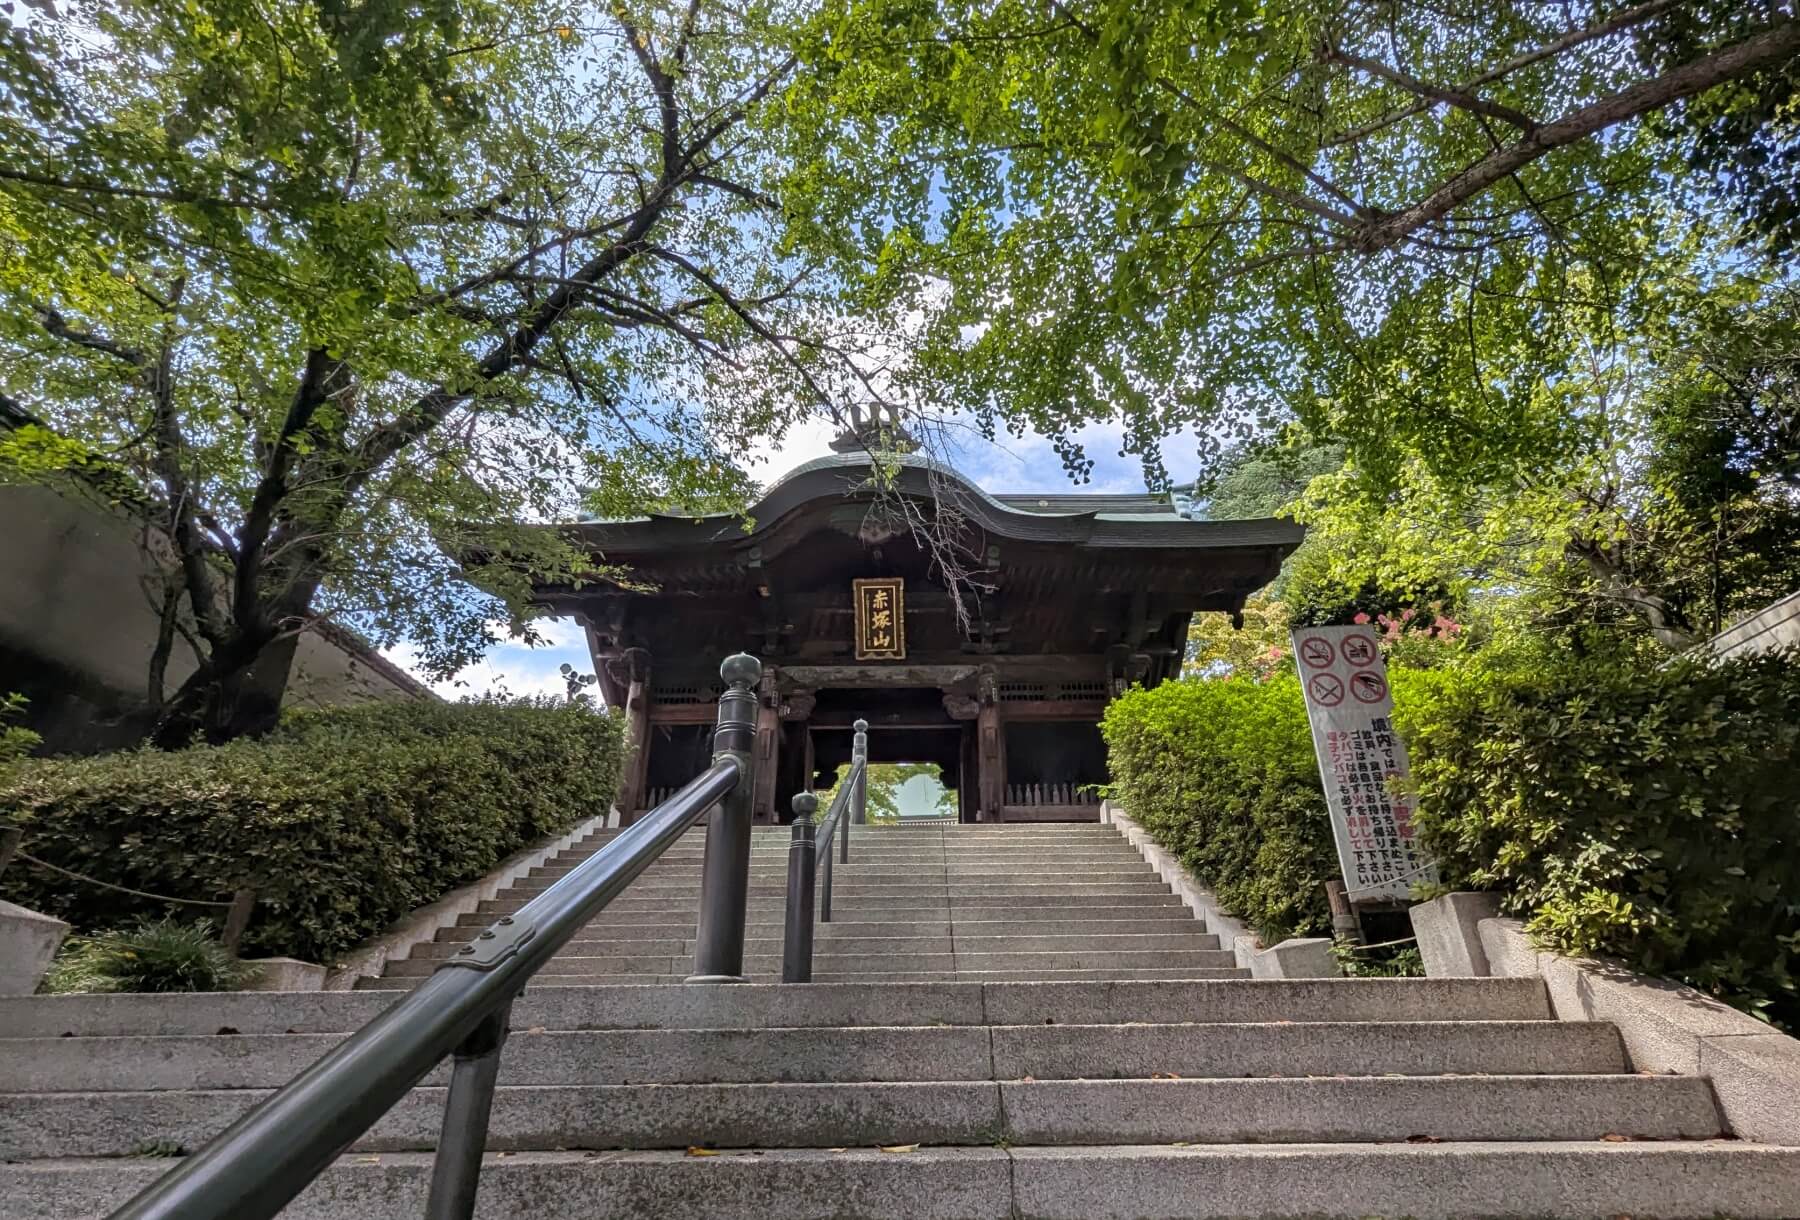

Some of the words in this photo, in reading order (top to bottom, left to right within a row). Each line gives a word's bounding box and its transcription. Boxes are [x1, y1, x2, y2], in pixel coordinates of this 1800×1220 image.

[872, 589, 892, 647] 赤塚山
[1327, 732, 1371, 888] 電子タバコも必ず消して下さい
